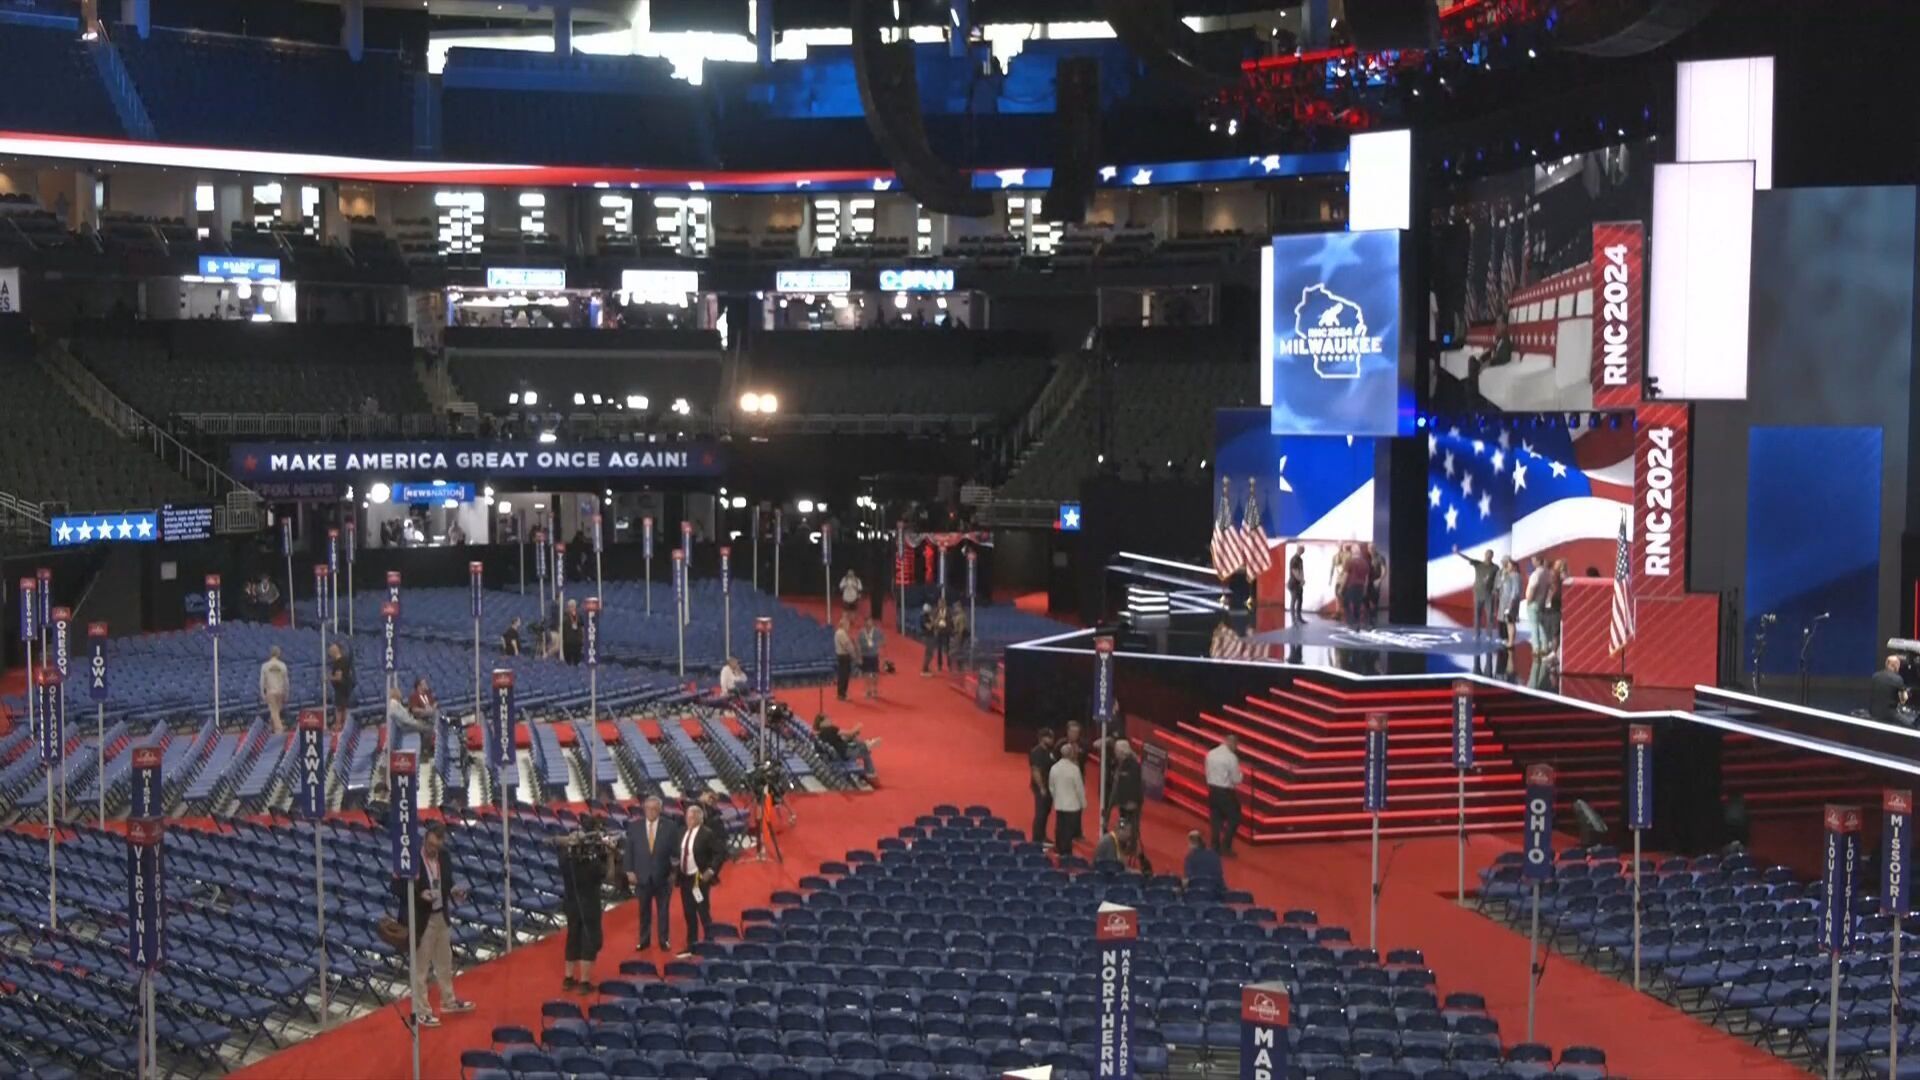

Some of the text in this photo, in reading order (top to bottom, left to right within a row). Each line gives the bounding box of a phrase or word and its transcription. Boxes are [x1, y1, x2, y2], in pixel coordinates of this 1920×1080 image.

[1279, 336, 1383, 355] MILWAUKEE
[271, 451, 687, 471] MAKE AMERICA GREAT ONCE AGAIN!
[208, 590, 216, 626] GUAM
[385, 614, 394, 669] INDIANA
[588, 611, 596, 665] FLORIDA
[91, 645, 106, 689] IOWA
[49, 685, 58, 758] OKLAHOMA
[499, 687, 509, 762] MINNESOTA
[1458, 696, 1467, 763] NEBRASKA
[304, 730, 320, 813] HAWAII
[397, 775, 411, 870] MICHIGAN
[1528, 798, 1547, 865] OHIO
[1824, 833, 1836, 946] LOUISIANA
[1842, 836, 1854, 947] LOUISIANA
[1889, 814, 1903, 909] MISSOURI
[134, 845, 146, 963] VIRGINIA
[153, 843, 163, 961] VIRGINIA
[1100, 950, 1117, 1077] NORTHERN
[1119, 948, 1131, 1076] MARIANA ISLANDS
